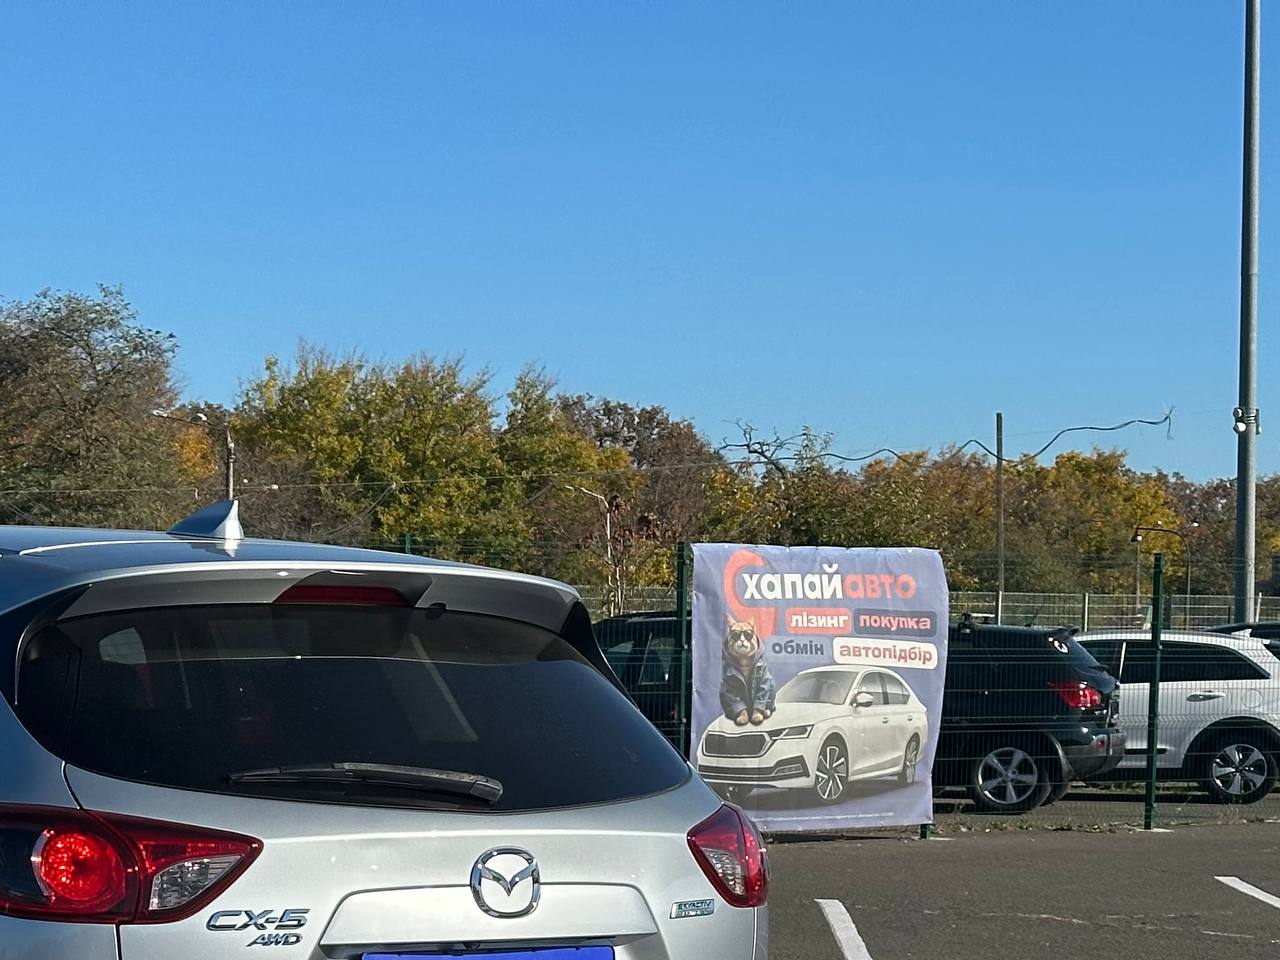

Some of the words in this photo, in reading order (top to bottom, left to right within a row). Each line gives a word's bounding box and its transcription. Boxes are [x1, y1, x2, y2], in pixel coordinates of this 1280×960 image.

[790, 611, 849, 628] лізинг
[859, 614, 931, 631] покупка
[772, 640, 824, 656] обмін
[839, 644, 933, 665] автопідбір
[205, 908, 311, 931] CX-5
[246, 932, 303, 947] AWD
